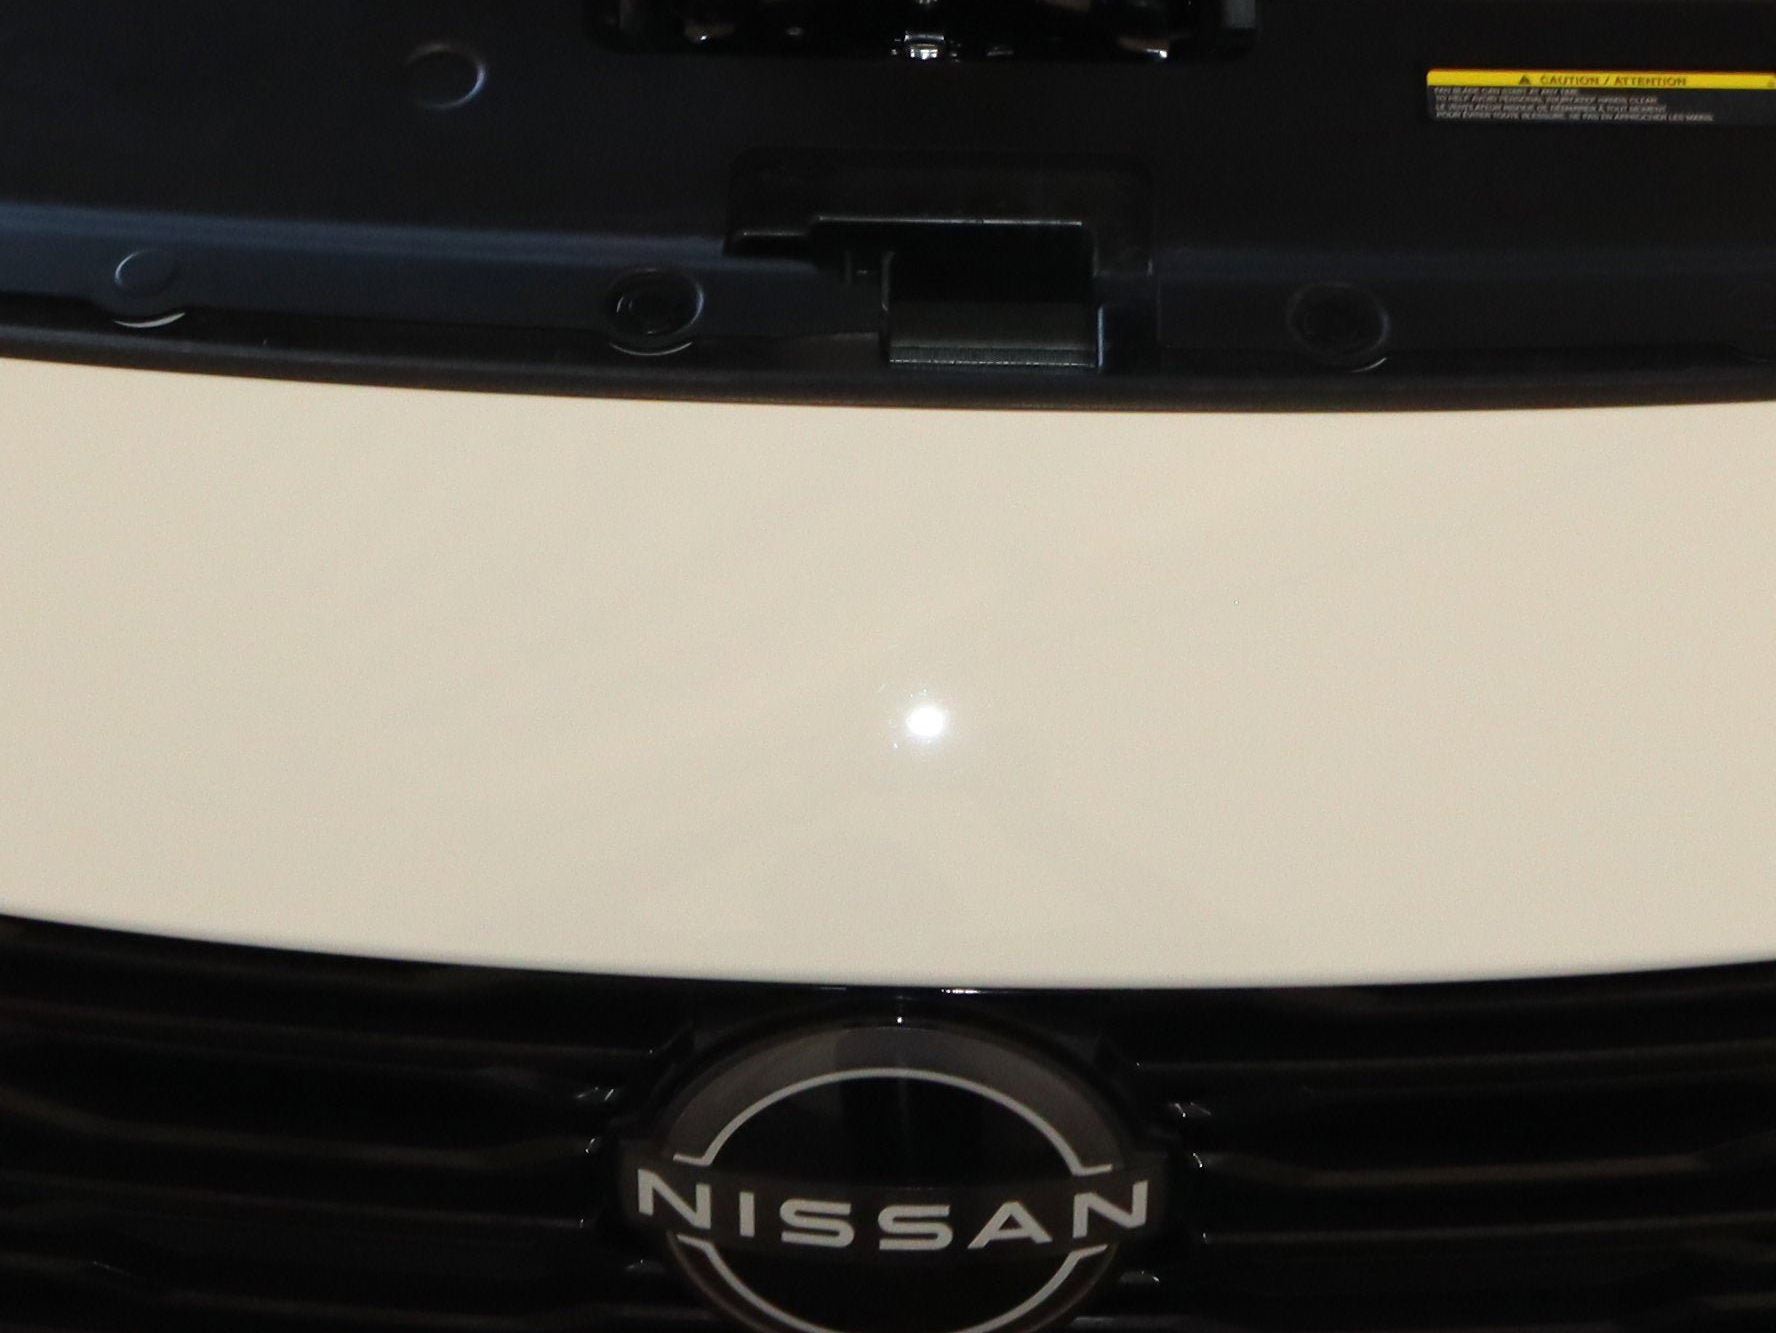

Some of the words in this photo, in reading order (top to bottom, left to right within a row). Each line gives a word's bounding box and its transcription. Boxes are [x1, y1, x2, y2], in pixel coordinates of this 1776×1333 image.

[1539, 75, 1599, 86] CAUTION
[1613, 76, 1687, 87] ATTENTION
[637, 1169, 1149, 1251] NISSAN
